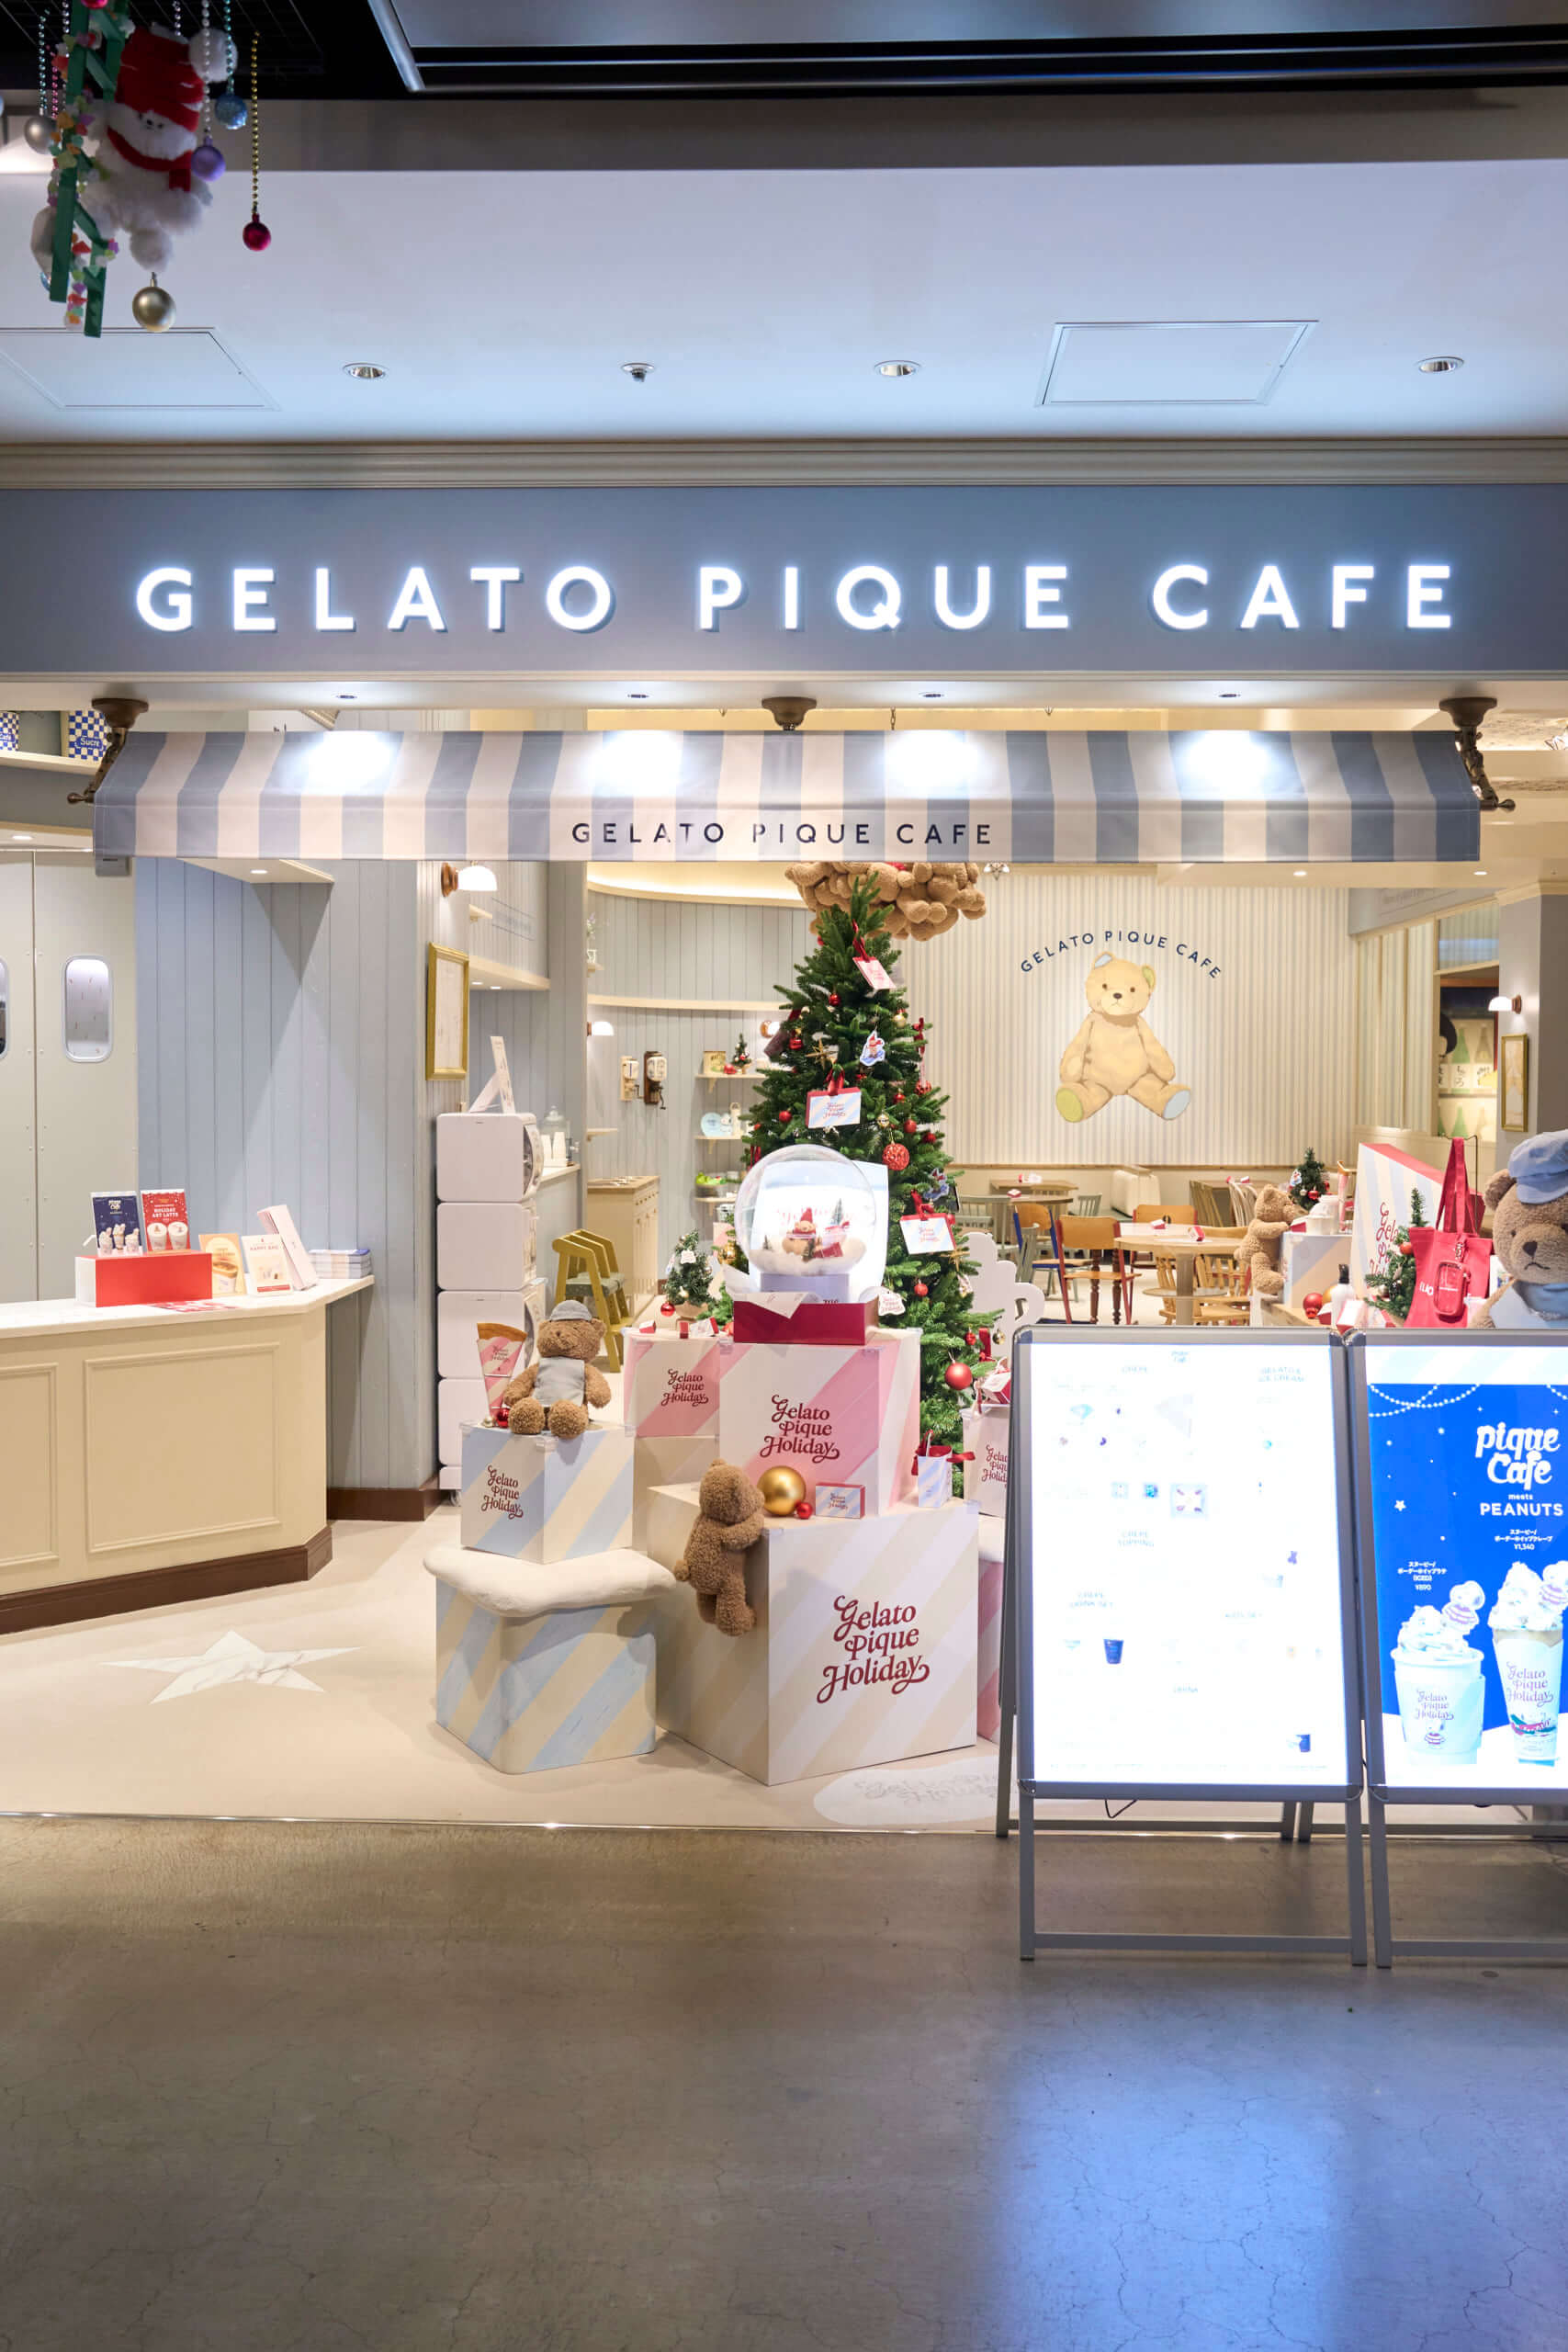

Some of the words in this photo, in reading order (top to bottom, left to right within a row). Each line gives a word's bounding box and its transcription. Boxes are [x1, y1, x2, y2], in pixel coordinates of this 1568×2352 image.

[135, 566, 615, 632] GELATO
[699, 564, 1069, 632] PIQUE
[1150, 563, 1452, 631] CAFE
[571, 822, 725, 844] GELATO
[752, 822, 872, 845] PIQUE
[896, 823, 991, 845] CAFE
[1021, 933, 1094, 973] GELATO
[1104, 930, 1168, 949] PIQUE
[1175, 944, 1222, 979] CAFE
[1376, 1202, 1399, 1242] Gela
[667, 1368, 704, 1385] Gelato
[671, 1382, 705, 1394] Pique
[660, 1392, 709, 1408] Holiday
[771, 1394, 829, 1423] Gelato
[778, 1420, 832, 1439] Pique
[760, 1435, 840, 1464] Holiday
[487, 1464, 519, 1488] Gelato
[981, 1468, 1008, 1483] Holid
[1486, 1451, 1552, 1490] Cafe
[491, 1485, 520, 1500] Pique
[480, 1495, 524, 1520] Holiday
[1480, 1502, 1564, 1517] PEANUTS
[833, 1595, 917, 1642] Gelato
[844, 1628, 919, 1661] Pique
[816, 1655, 931, 1703] Holiday
[1506, 1661, 1547, 1681] Gelato
